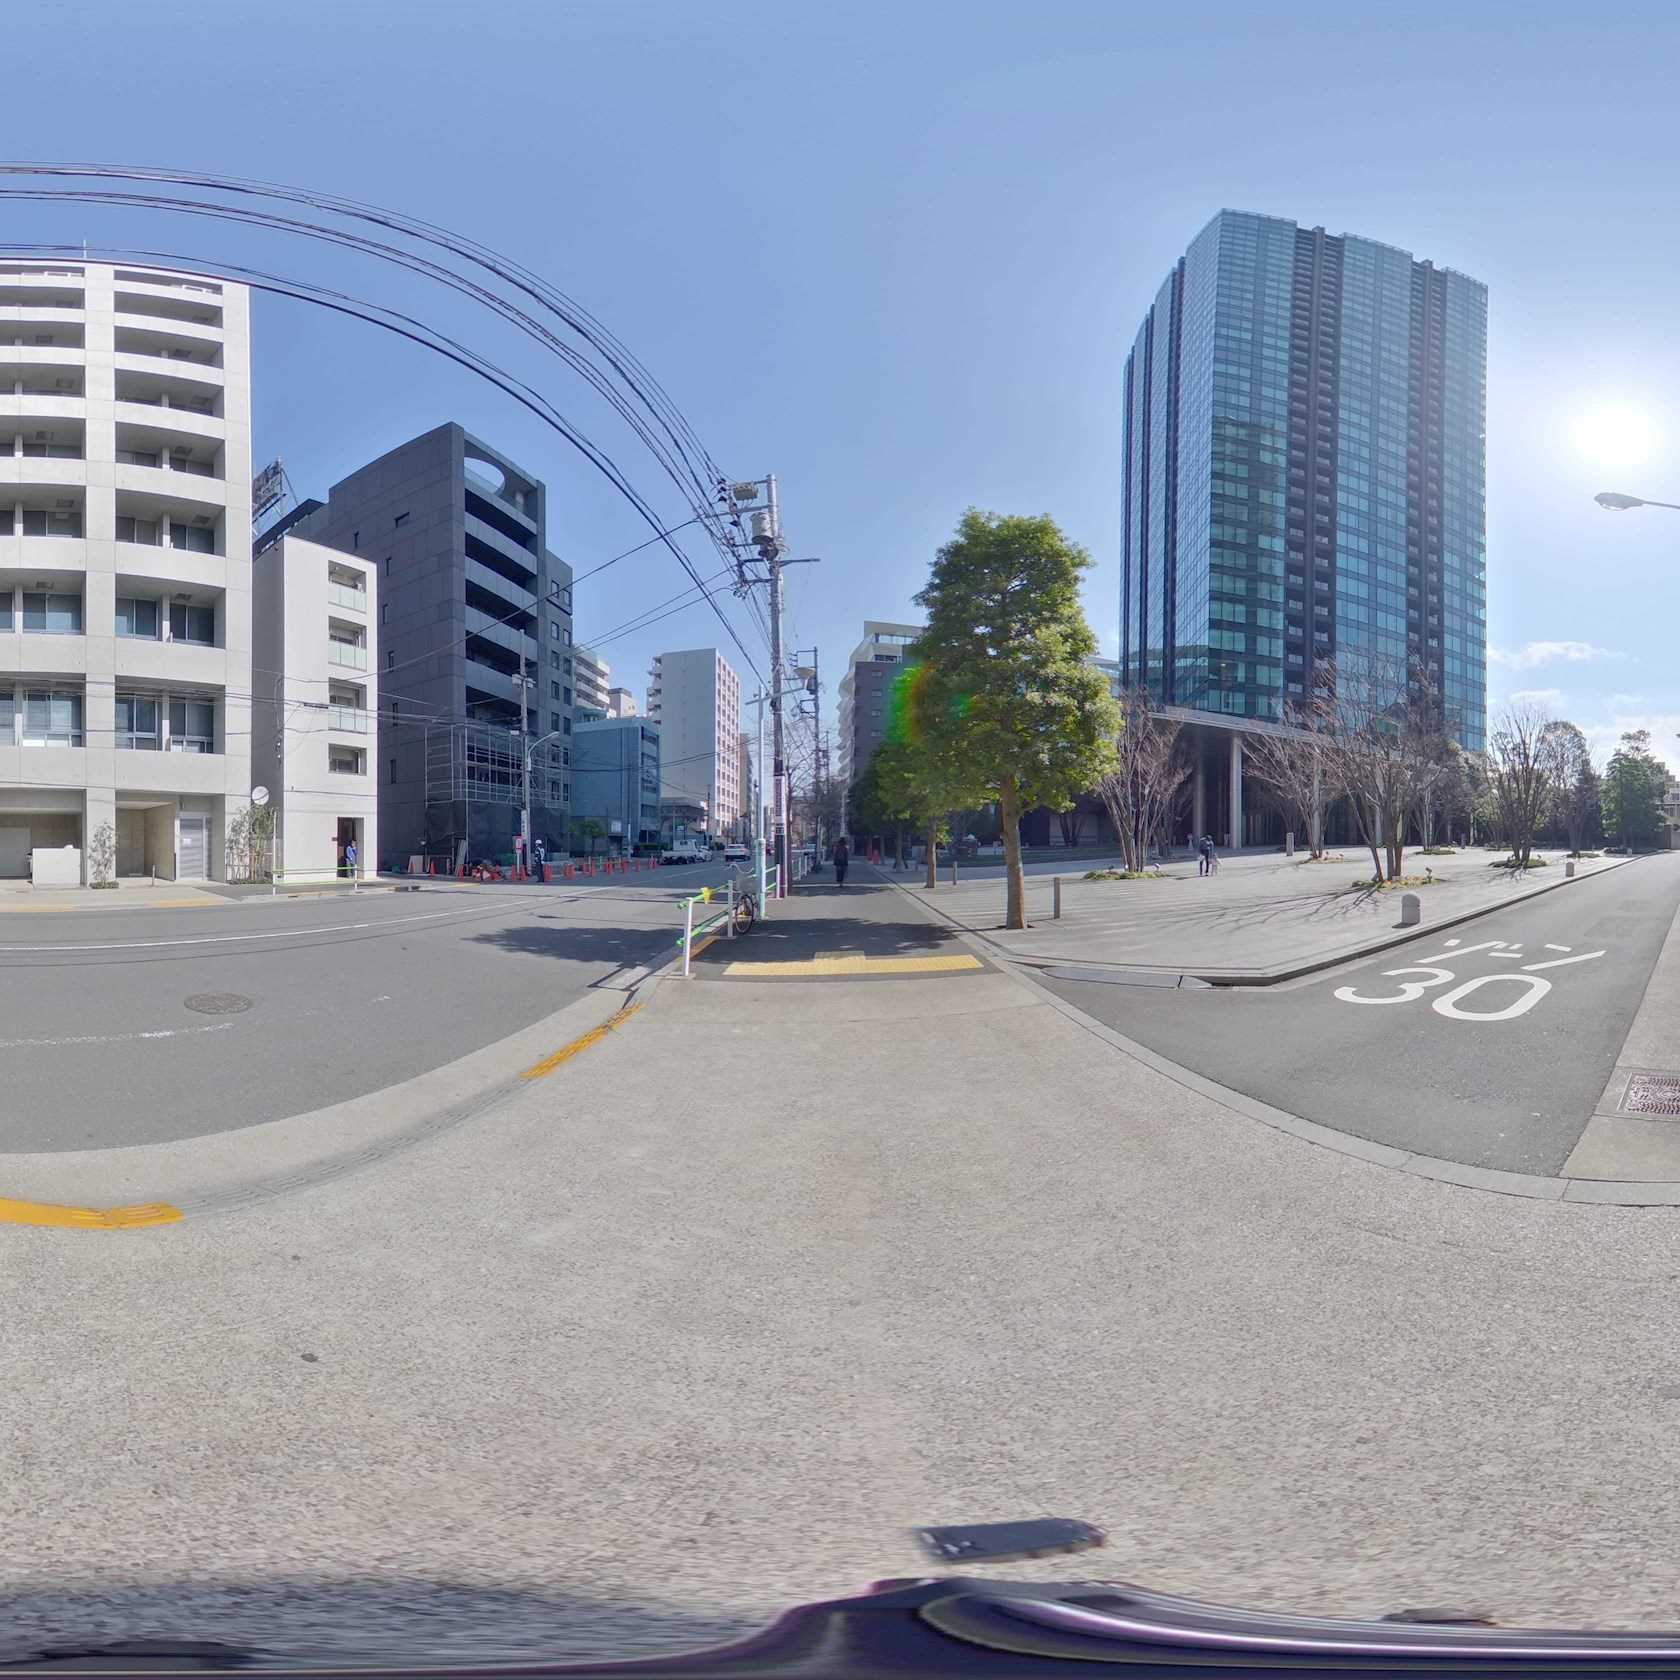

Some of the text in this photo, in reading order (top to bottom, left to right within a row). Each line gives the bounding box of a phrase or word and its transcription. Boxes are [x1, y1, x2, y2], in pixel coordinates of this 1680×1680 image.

[1413, 939, 1607, 972] ゾーン
[1333, 966, 1552, 1021] 30
